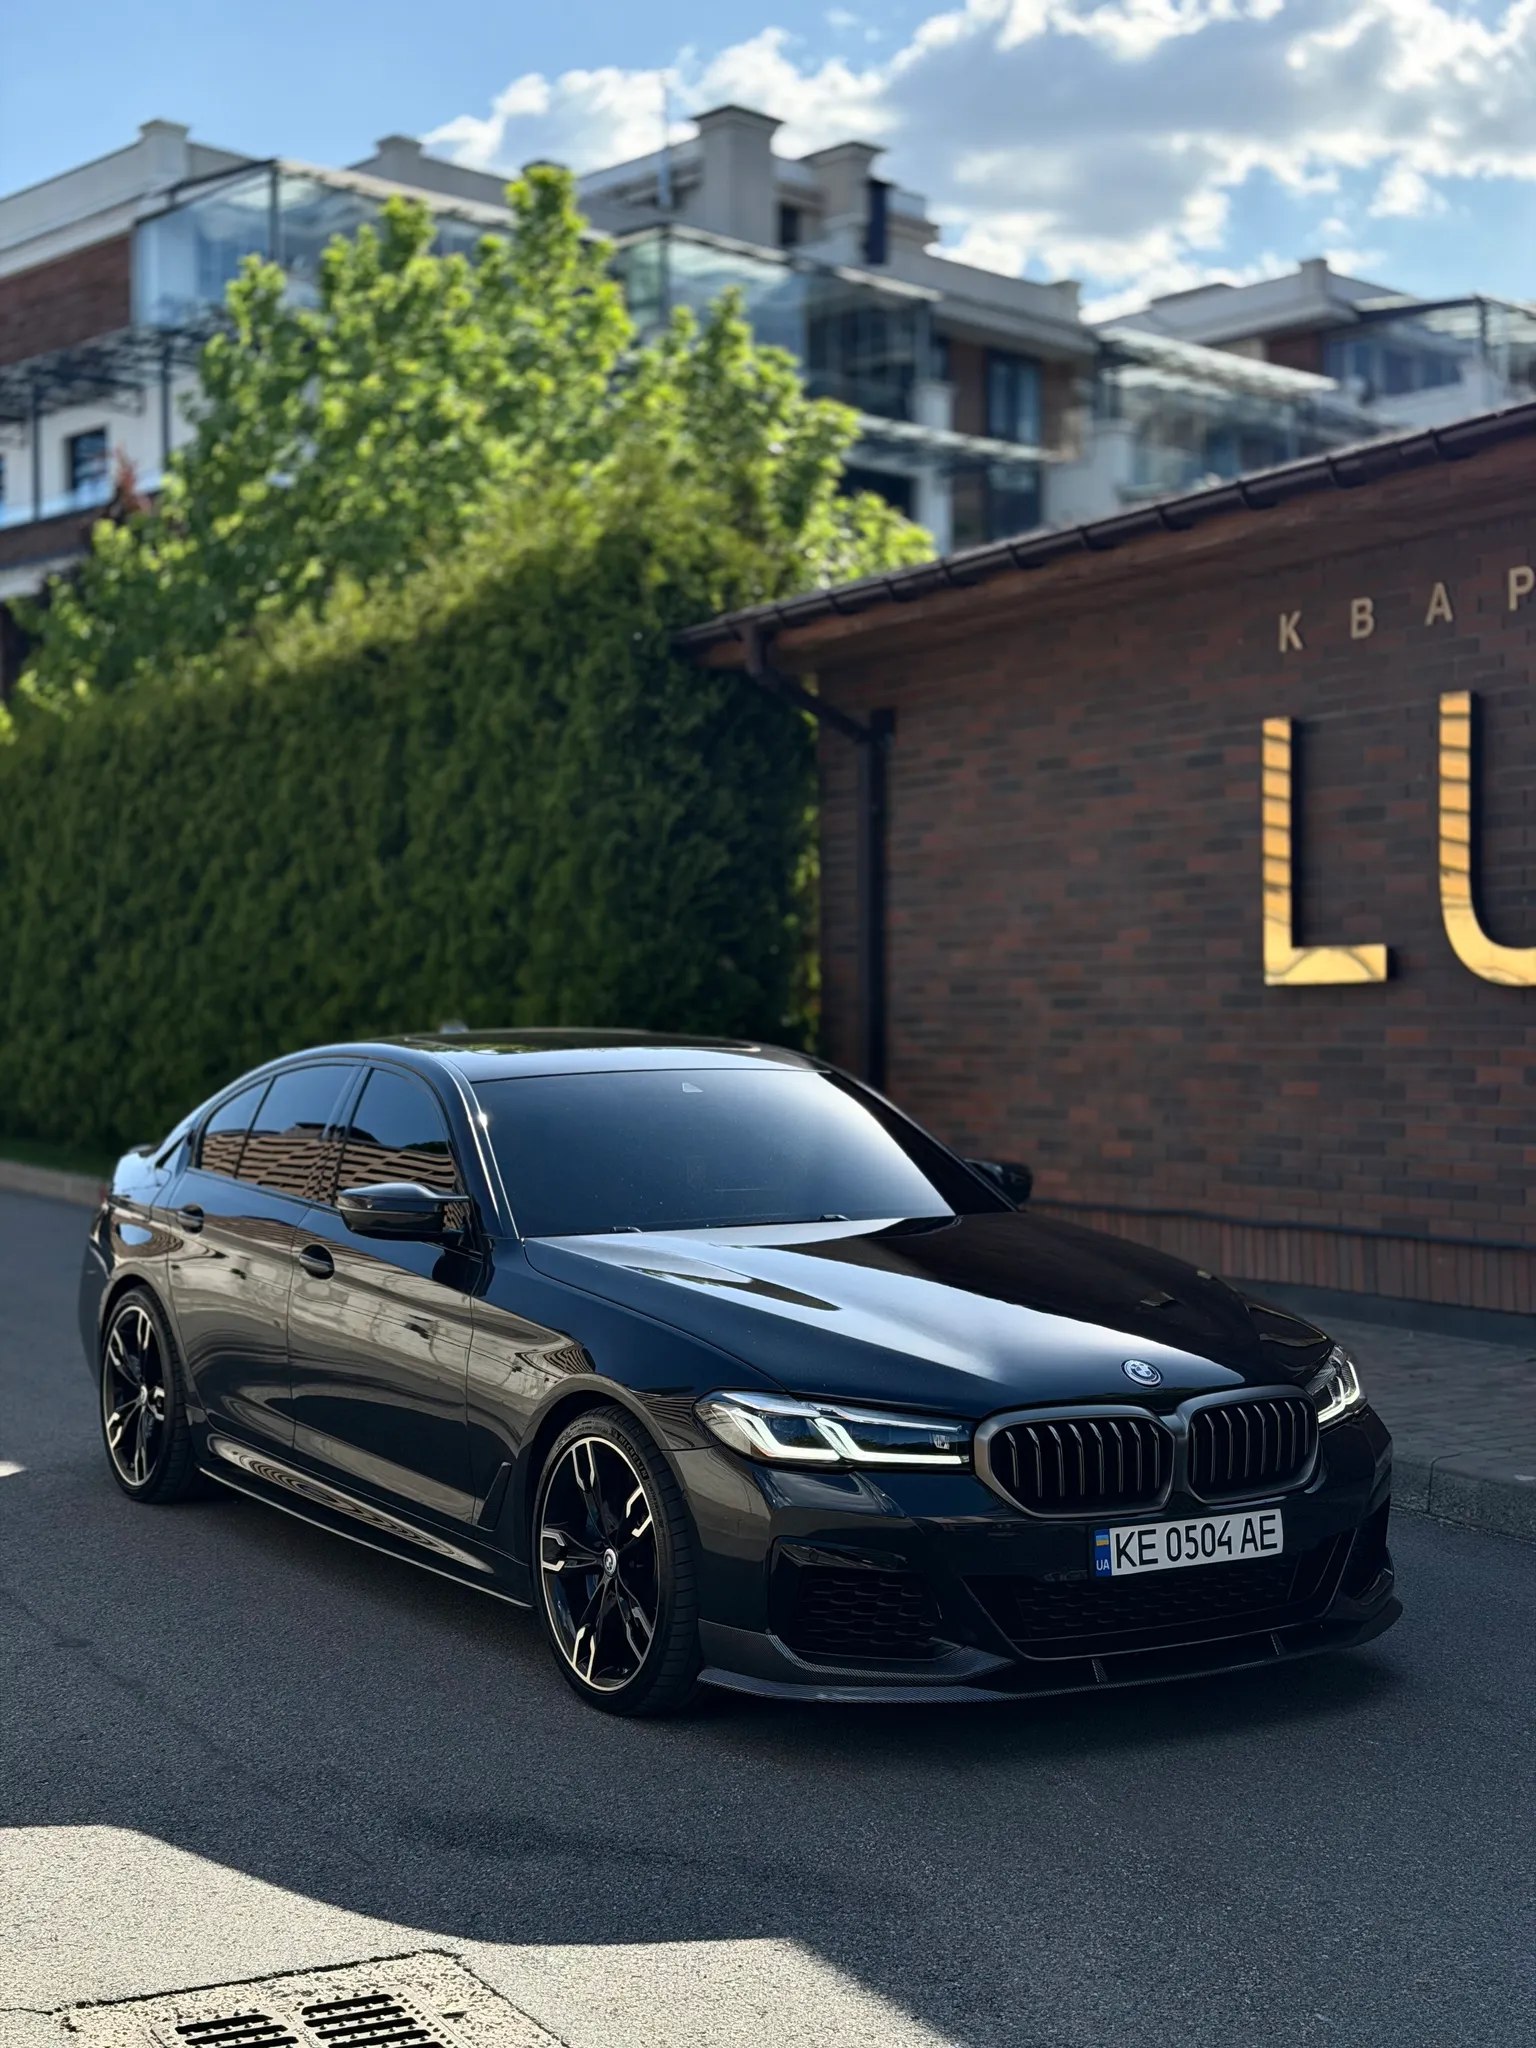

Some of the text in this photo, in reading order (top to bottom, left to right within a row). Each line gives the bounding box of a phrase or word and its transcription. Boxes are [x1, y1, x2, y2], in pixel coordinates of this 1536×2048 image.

[618, 1436, 648, 1478] MICHELIN
[1115, 1514, 1278, 1568] KE 0504 AE
[1096, 1559, 1110, 1571] UA
